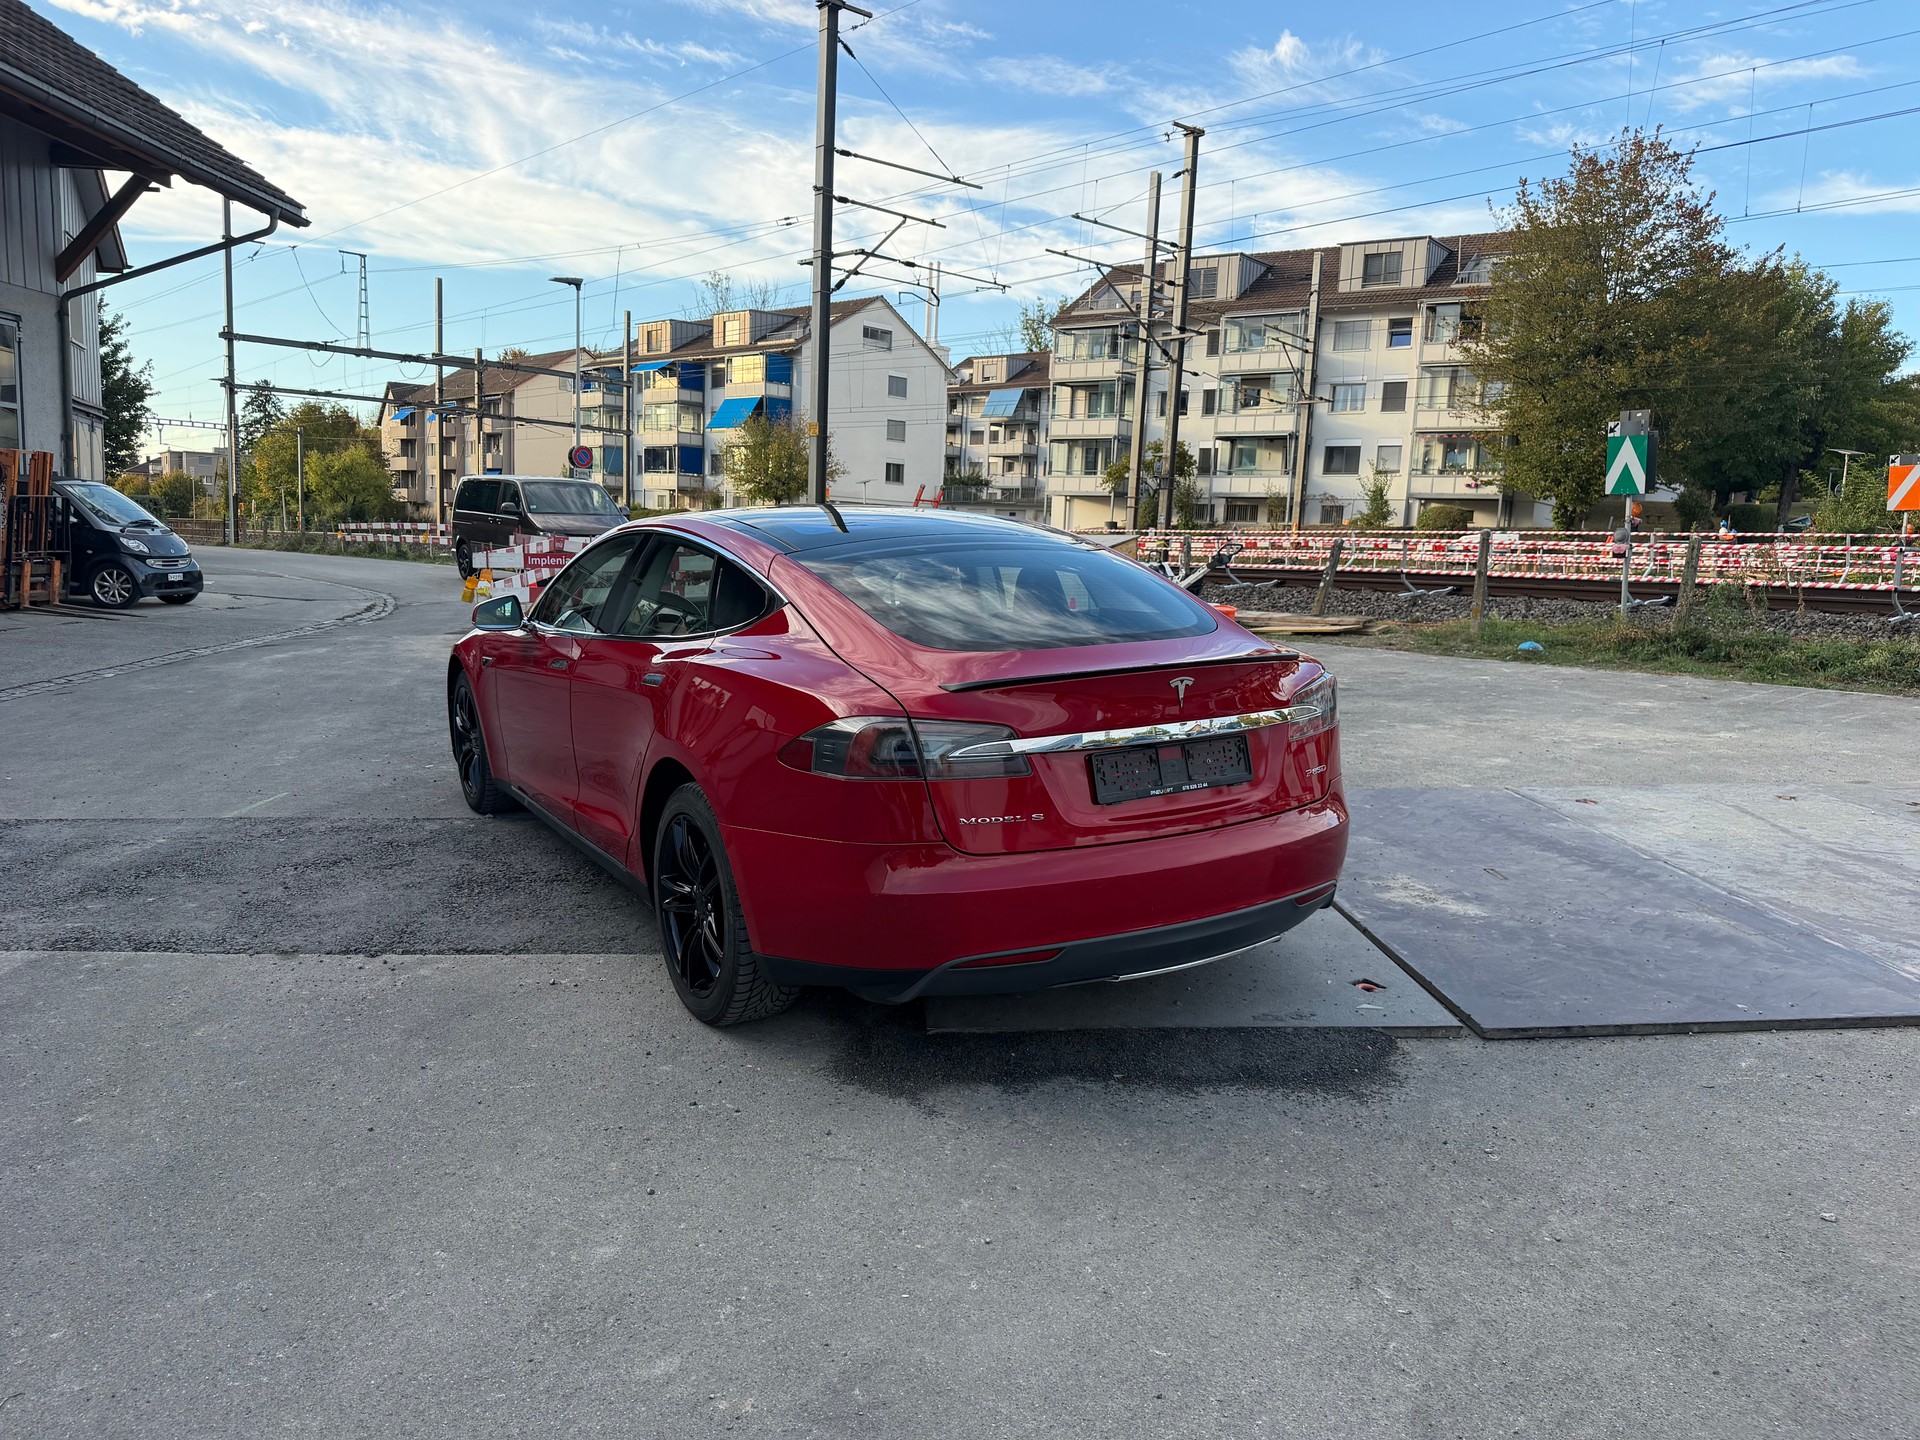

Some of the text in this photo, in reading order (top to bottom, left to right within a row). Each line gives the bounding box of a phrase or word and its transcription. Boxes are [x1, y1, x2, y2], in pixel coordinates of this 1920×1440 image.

[527, 555, 571, 566] Implenia
[959, 813, 1045, 825] MODEL S
